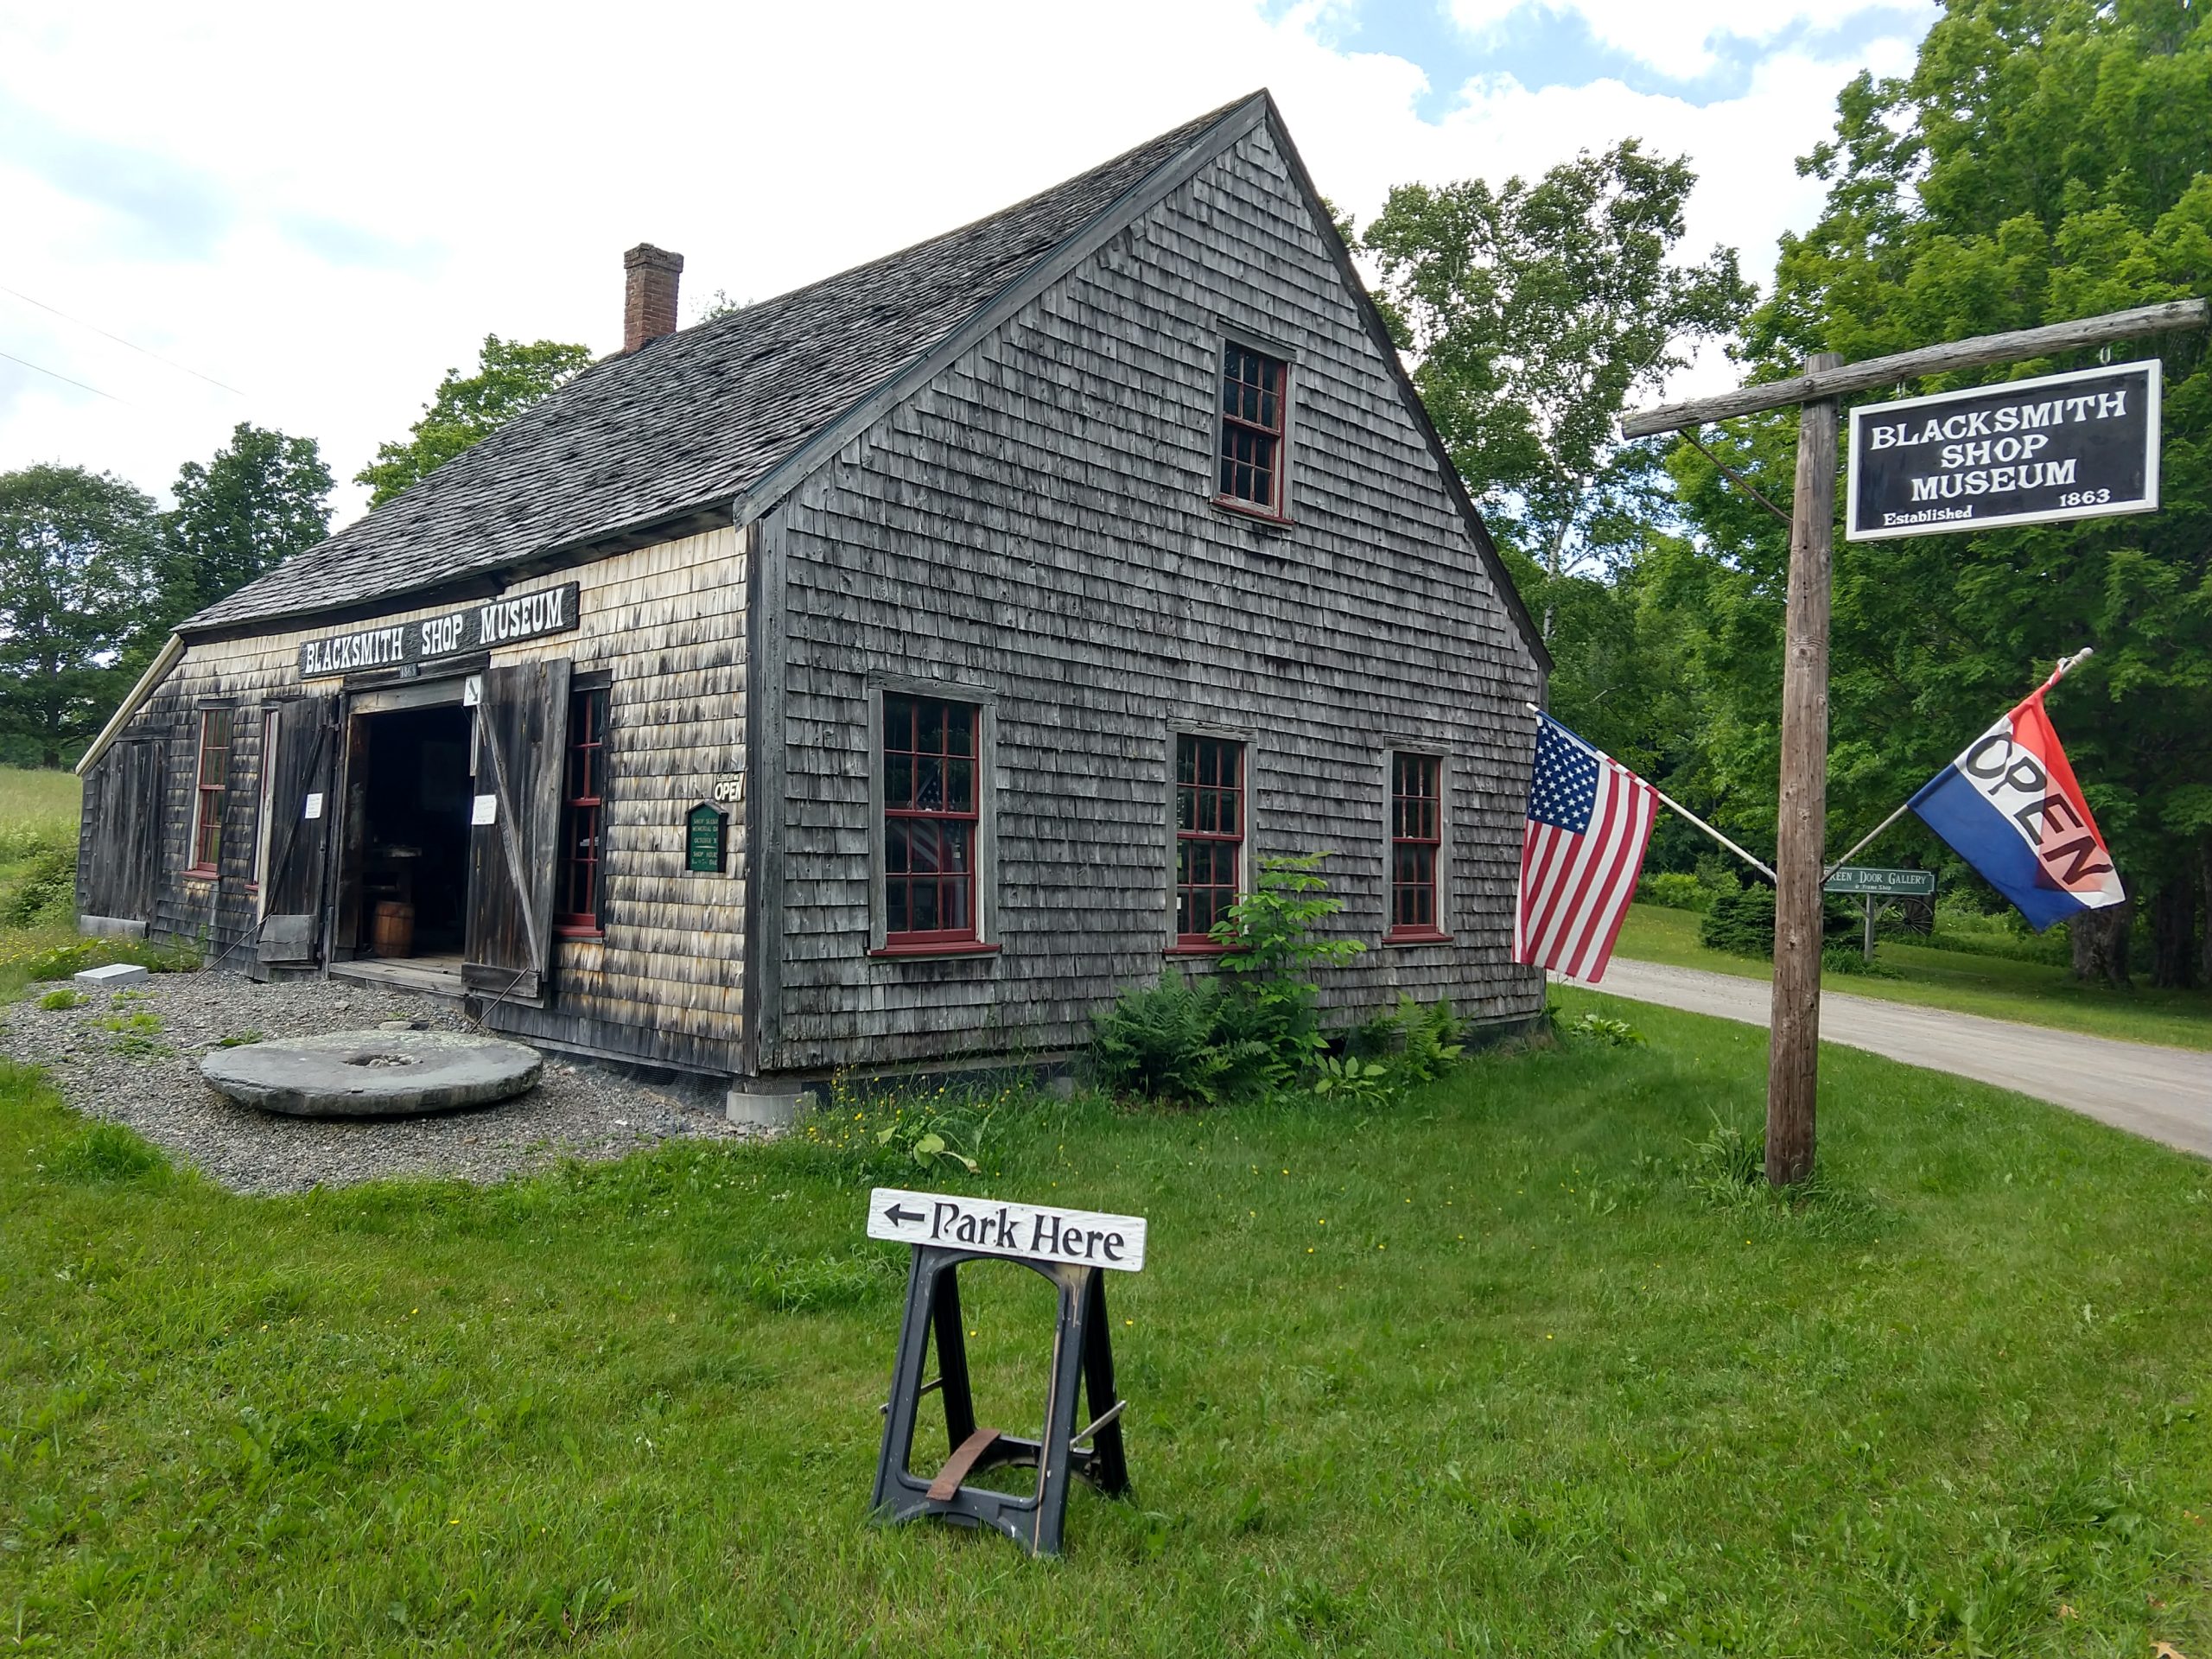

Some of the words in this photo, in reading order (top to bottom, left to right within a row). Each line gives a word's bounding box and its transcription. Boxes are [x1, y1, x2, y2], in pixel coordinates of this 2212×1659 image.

[1870, 391, 2127, 451] BLACKSMITH
[1941, 434, 2049, 468] SHOP
[1910, 459, 2077, 502] MUSEUM
[1883, 505, 1974, 527] Established
[2059, 488, 2111, 508] 1863
[305, 626, 404, 674] BLACKSMITH
[422, 613, 463, 656] SHOP
[480, 588, 565, 645] MUSEUM
[715, 781, 741, 802] OPEN
[1966, 731, 2115, 886] OPEN
[931, 1202, 1020, 1249] Park
[1030, 1213, 1124, 1261] Here
